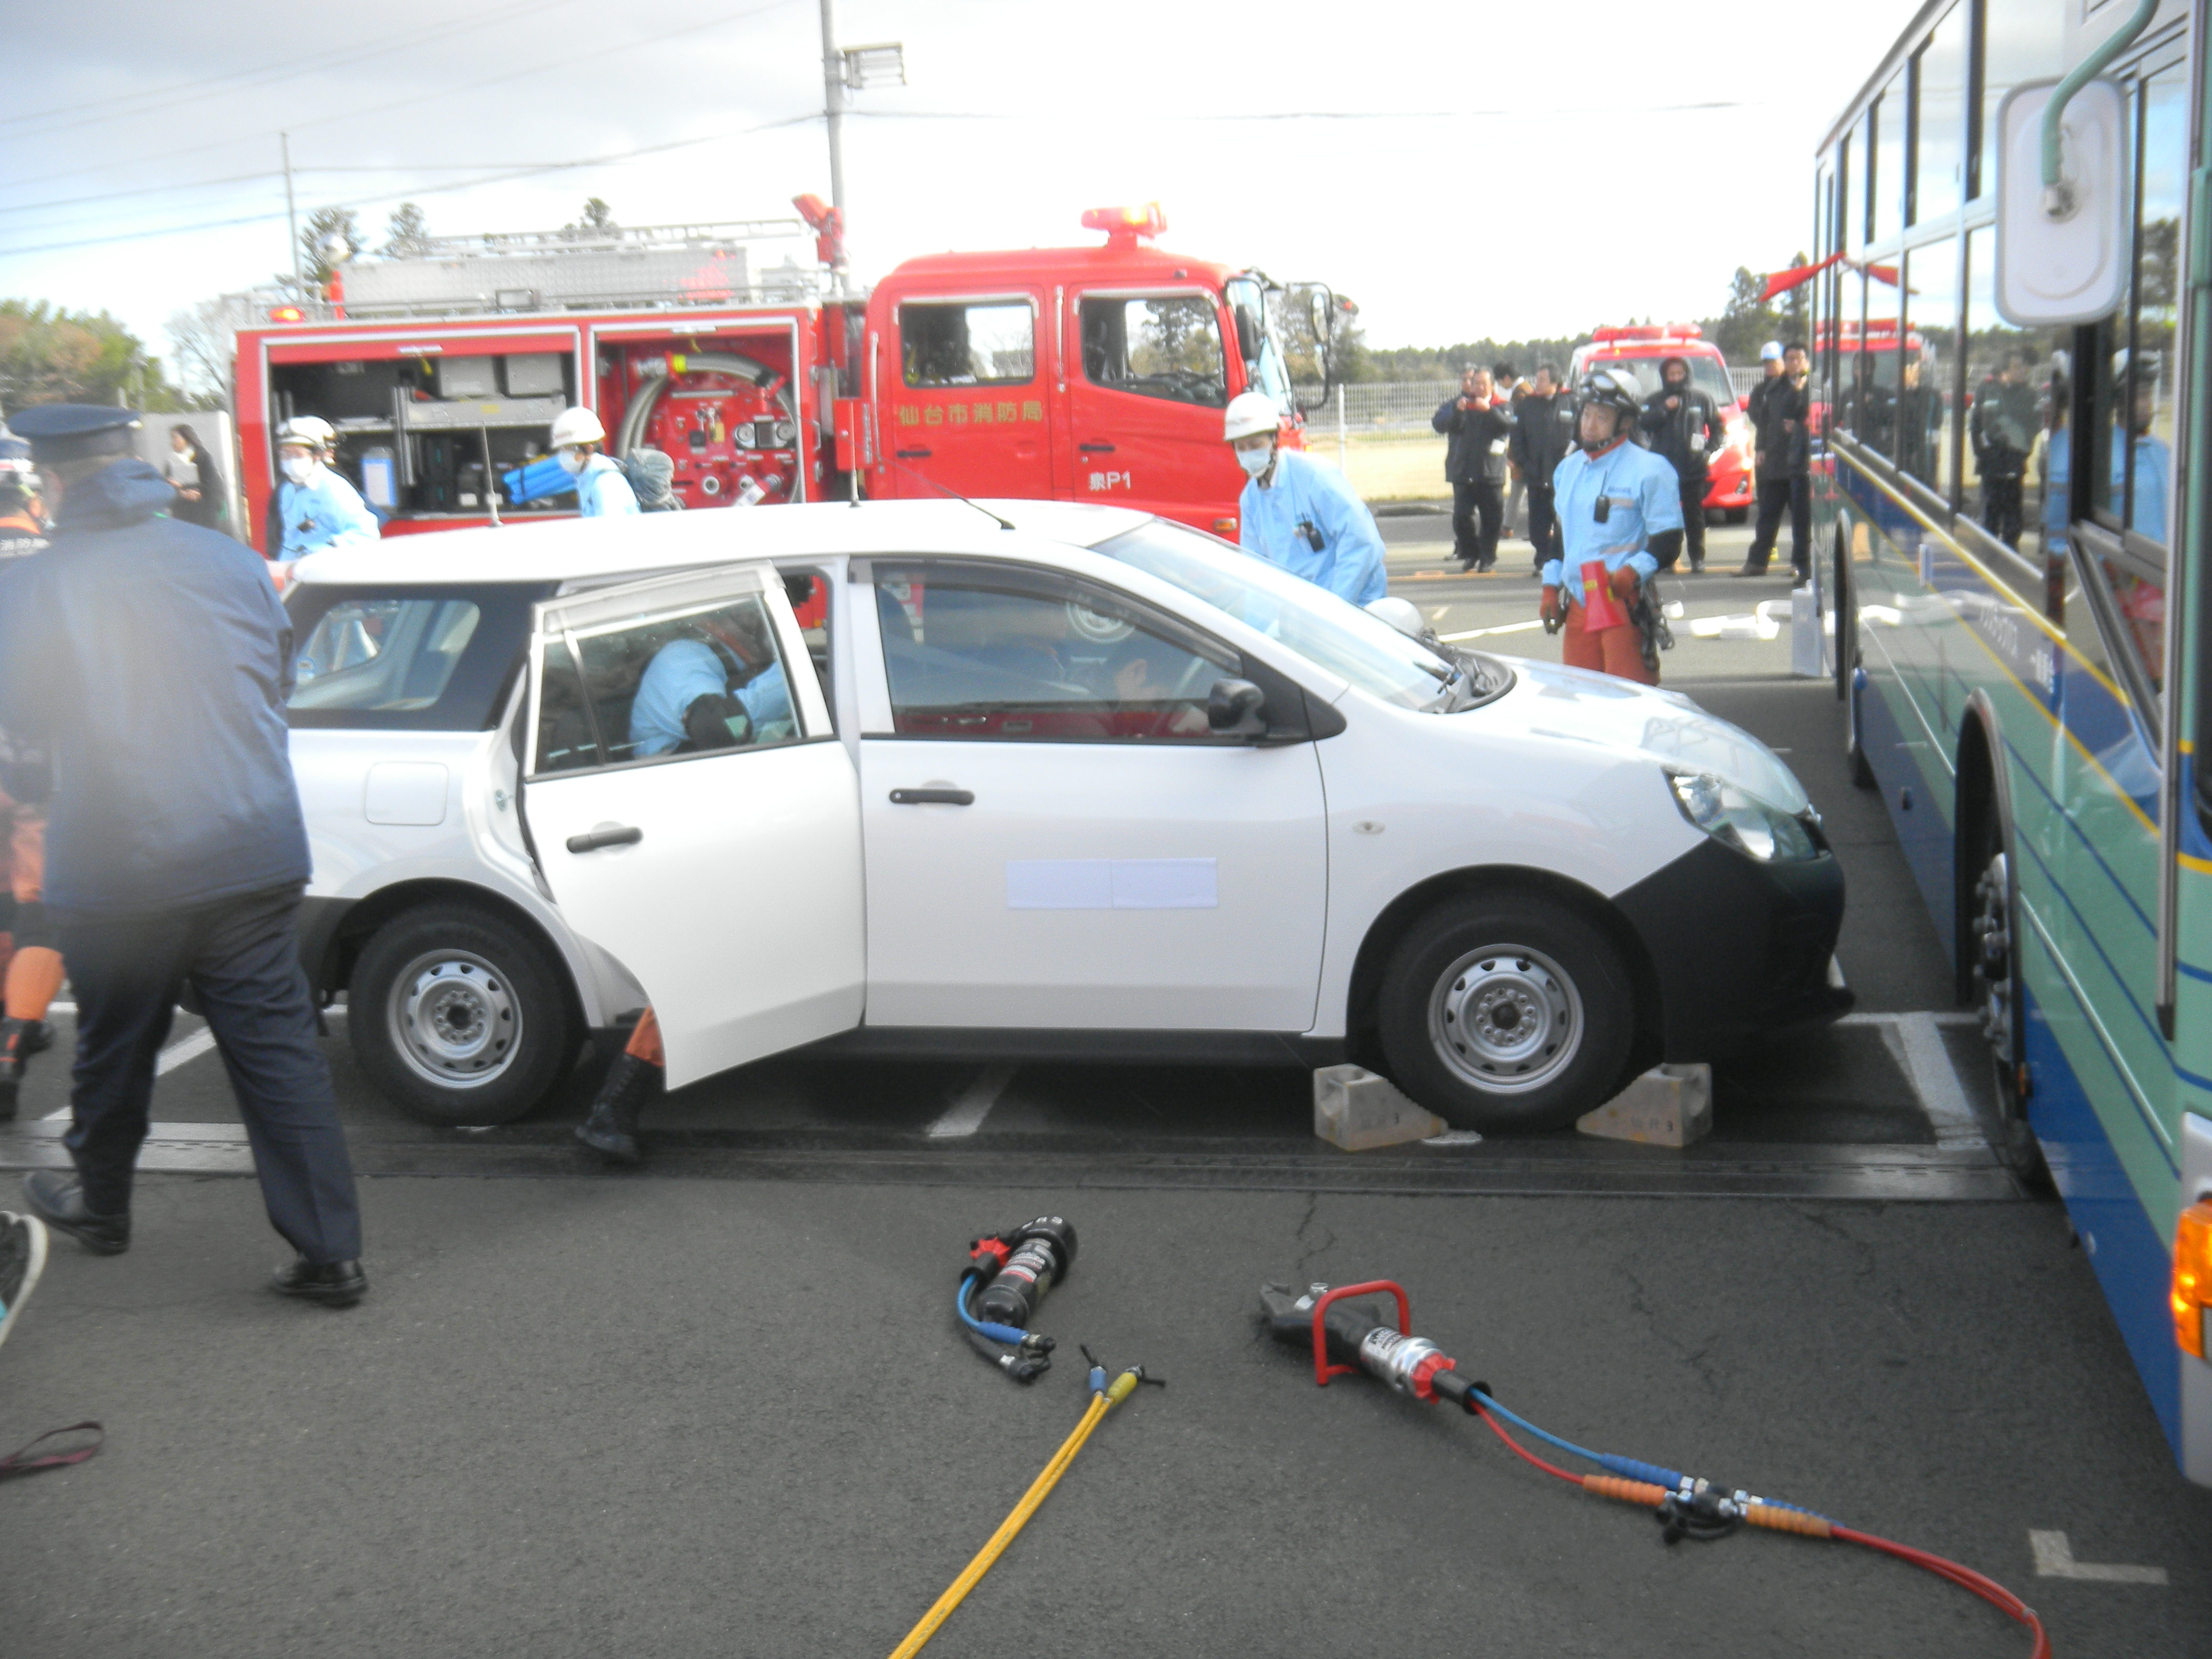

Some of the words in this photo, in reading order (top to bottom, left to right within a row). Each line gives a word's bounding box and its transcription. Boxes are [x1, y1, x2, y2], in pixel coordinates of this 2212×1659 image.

[899, 400, 1043, 427] 仙台市消防局
